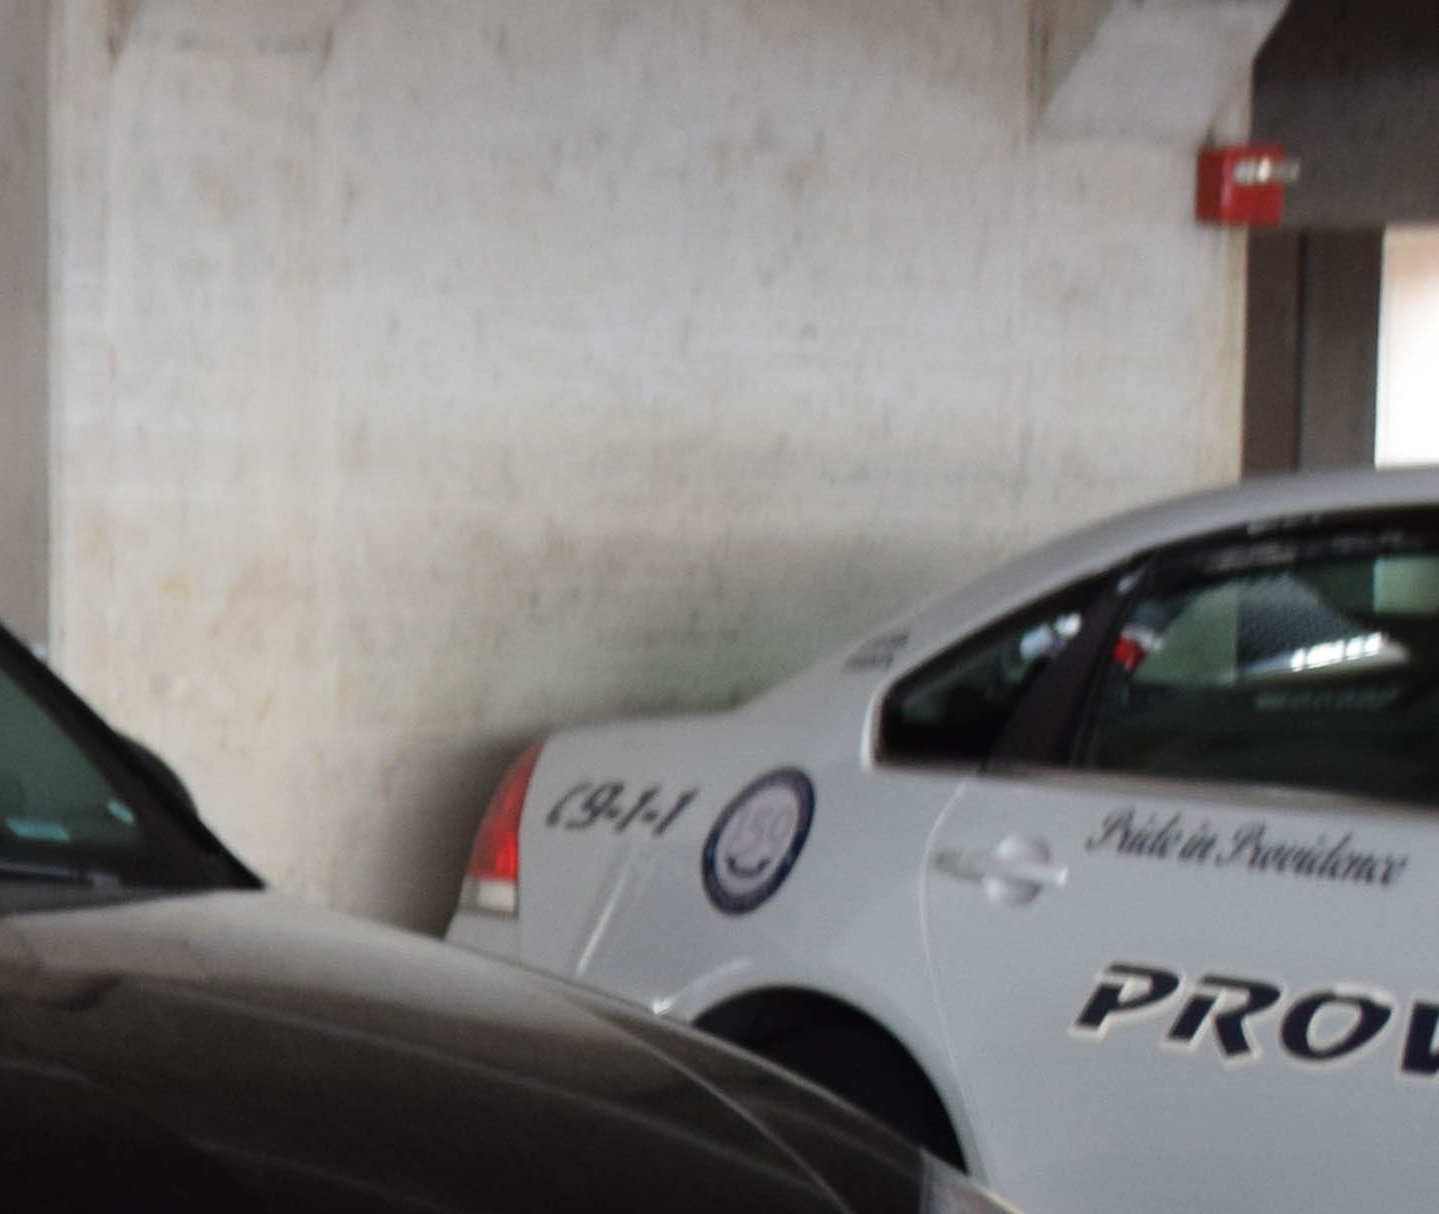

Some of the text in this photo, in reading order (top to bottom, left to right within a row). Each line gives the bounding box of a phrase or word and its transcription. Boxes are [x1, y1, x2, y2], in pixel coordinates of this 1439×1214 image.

[1085, 805, 1407, 886] Pride in Providence
